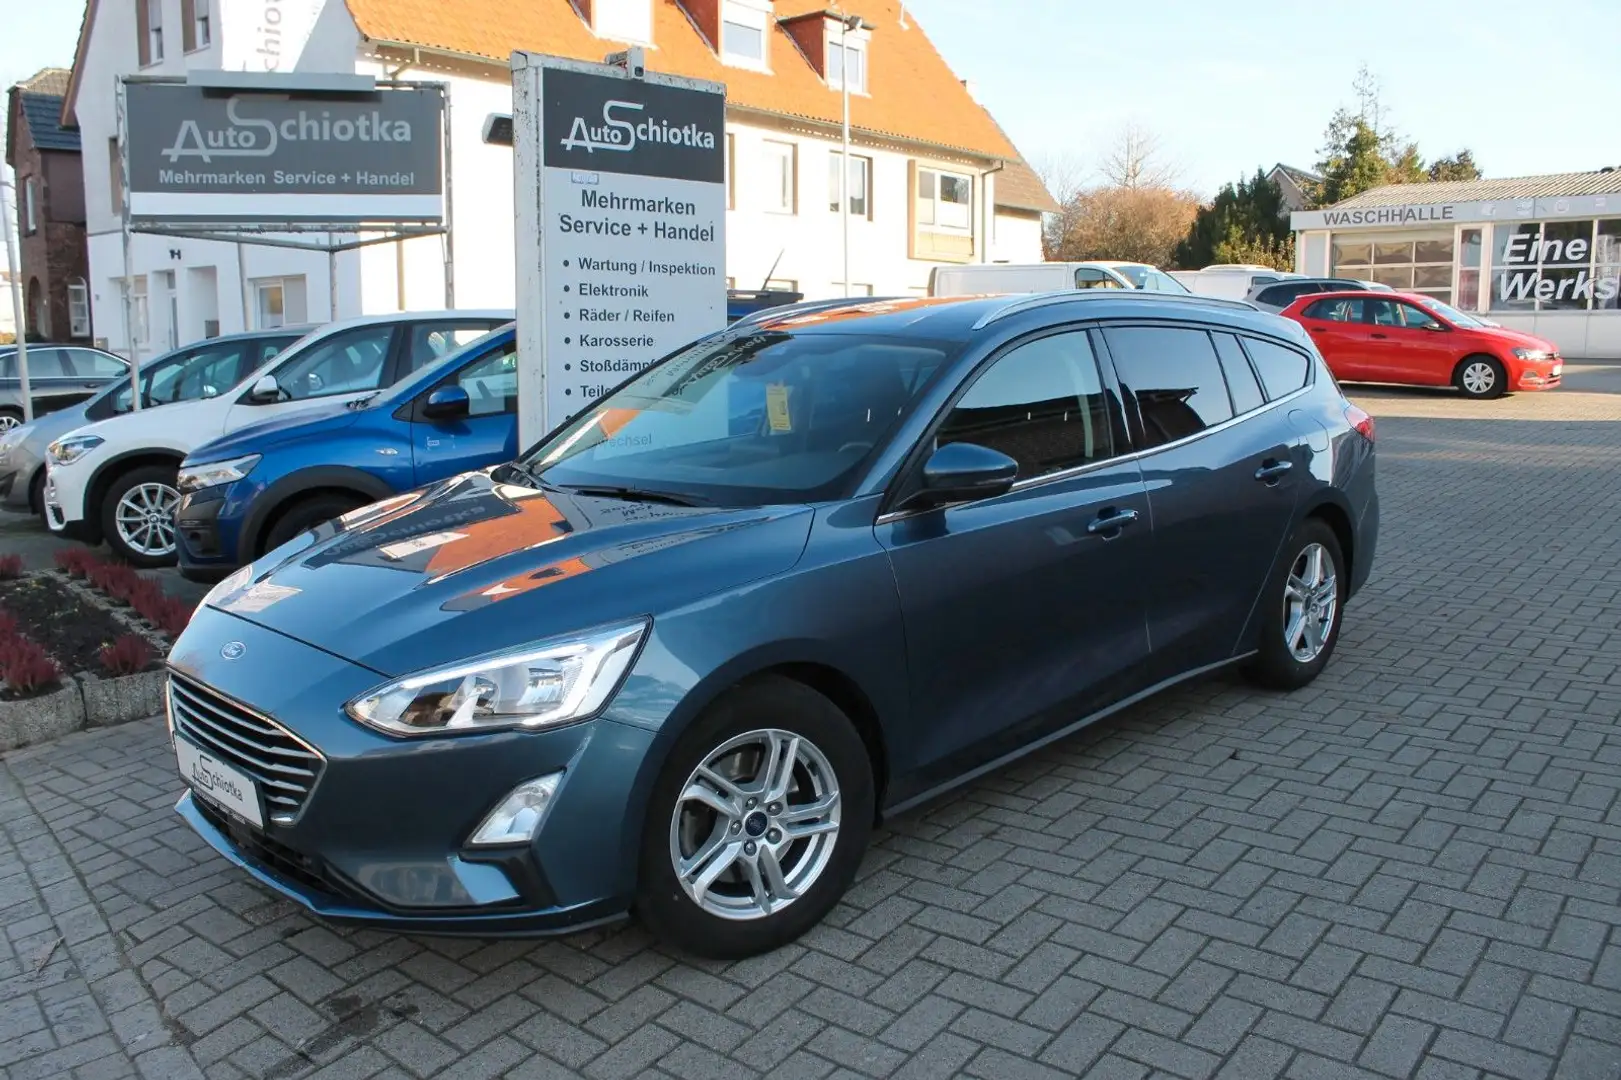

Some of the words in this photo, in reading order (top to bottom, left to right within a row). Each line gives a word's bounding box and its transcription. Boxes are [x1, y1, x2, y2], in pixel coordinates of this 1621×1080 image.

[255, 0, 281, 71] chio
[159, 169, 265, 185] Mehrmarken
[274, 170, 336, 185] Service
[356, 171, 415, 186] Handel
[581, 189, 695, 216] Mehrmarken
[1323, 205, 1454, 226] WASCHHALLE
[559, 215, 631, 236] Service
[654, 221, 714, 241] Handel
[1502, 233, 1588, 262] Eine
[579, 257, 637, 275] Wartung
[649, 261, 715, 276] Inspektion
[579, 283, 649, 298] Elektronik
[1501, 271, 1617, 302] Werks
[580, 308, 620, 322] Räder
[633, 310, 675, 322] Reifen
[580, 334, 654, 347] Karosserie
